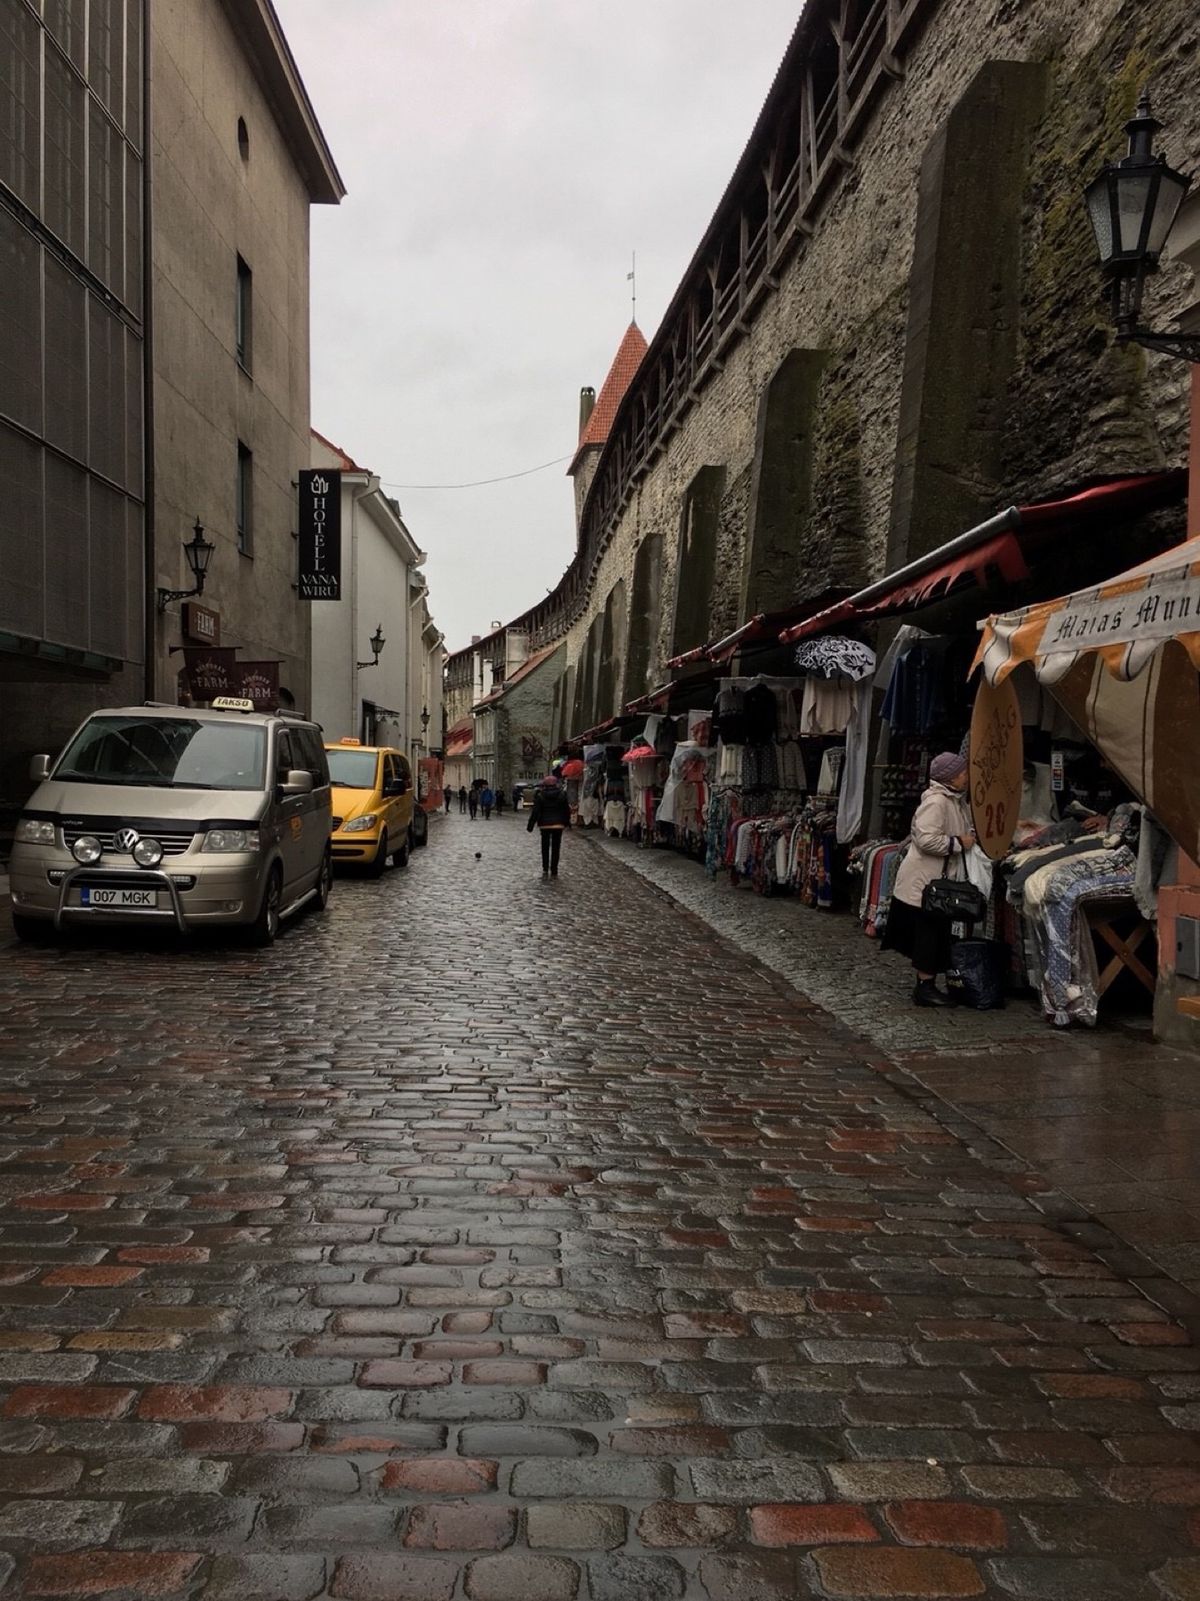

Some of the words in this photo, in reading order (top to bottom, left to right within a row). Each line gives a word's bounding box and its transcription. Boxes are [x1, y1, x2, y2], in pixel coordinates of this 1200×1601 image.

[313, 497, 326, 571] HOTELL
[301, 574, 338, 585] VANA
[302, 586, 338, 597] WIRU
[197, 611, 215, 637] FARM
[197, 676, 228, 689] FARM
[242, 687, 271, 698] FARM
[217, 697, 249, 707] TAKSO
[94, 891, 117, 903] 007
[122, 892, 151, 904] MGK
